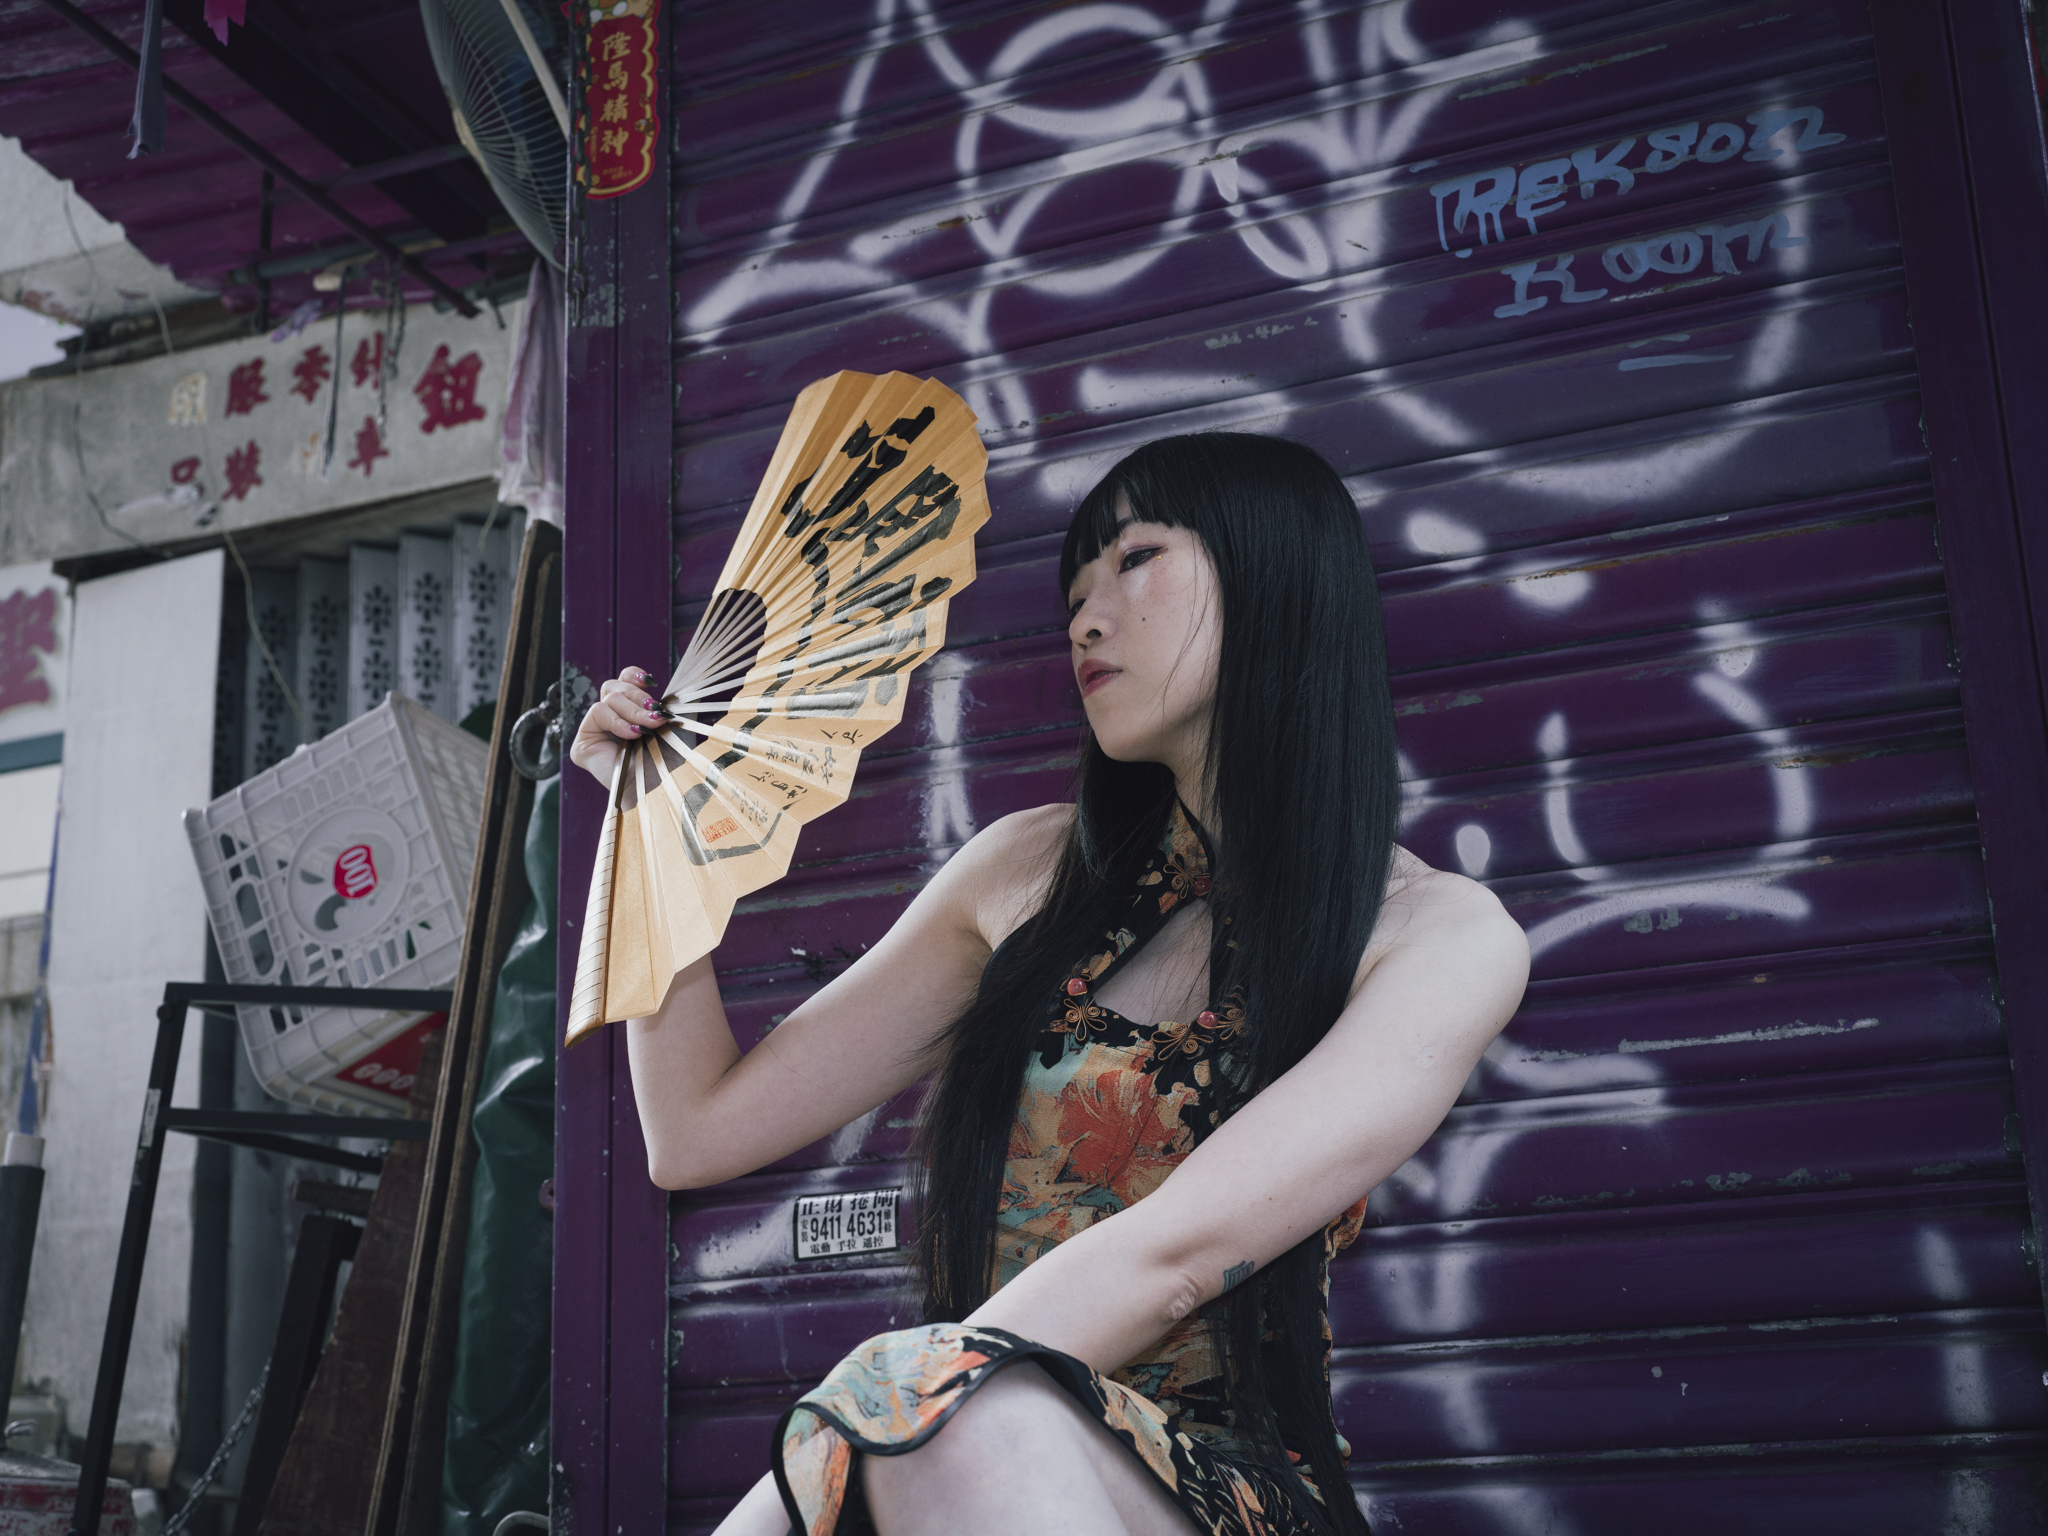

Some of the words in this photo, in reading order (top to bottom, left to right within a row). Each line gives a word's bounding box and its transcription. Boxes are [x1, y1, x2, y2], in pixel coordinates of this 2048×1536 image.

[338, 846, 376, 897] 100
[810, 1214, 841, 1241] 9411
[846, 1210, 882, 1237] 4631
[810, 1242, 831, 1254] 電動
[838, 1238, 858, 1251] 手拉
